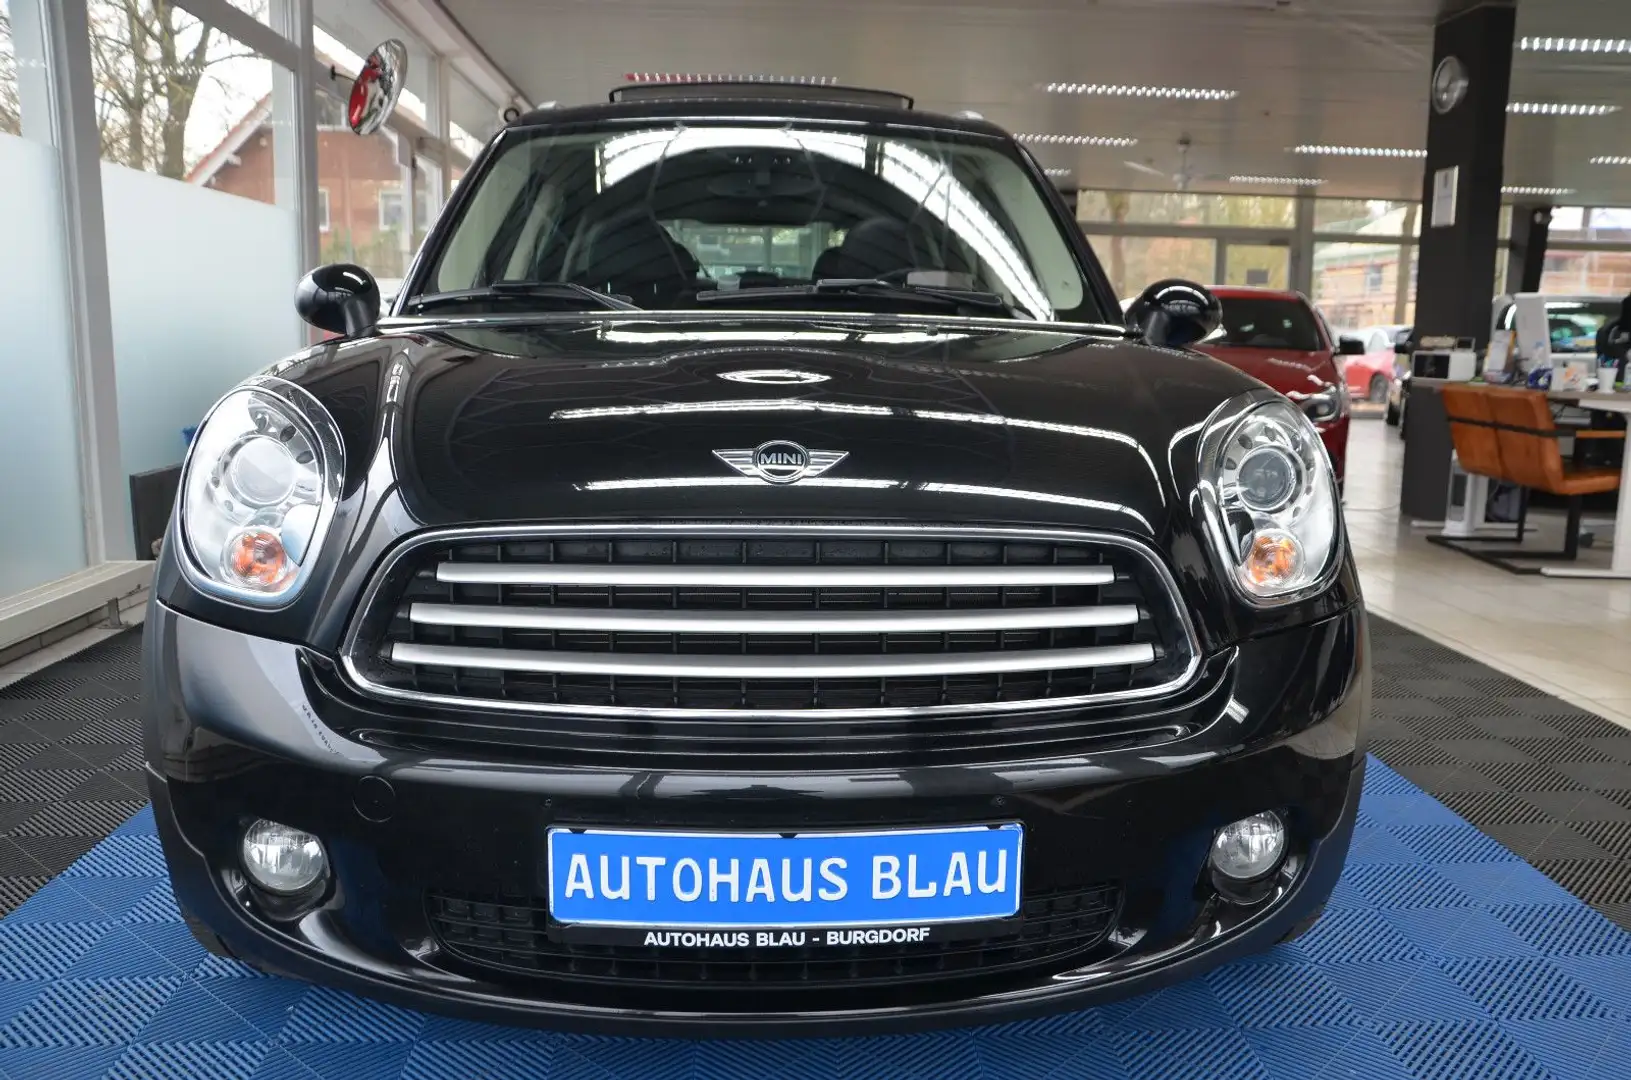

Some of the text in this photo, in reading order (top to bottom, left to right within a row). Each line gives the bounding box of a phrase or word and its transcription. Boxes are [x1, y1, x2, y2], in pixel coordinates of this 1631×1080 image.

[760, 453, 802, 465] MINI
[564, 849, 1007, 902] AUTOHAUS BLAU
[644, 930, 749, 947] AUTOHAUS
[756, 930, 806, 946] BLAU
[826, 927, 931, 945] BURGDORF
